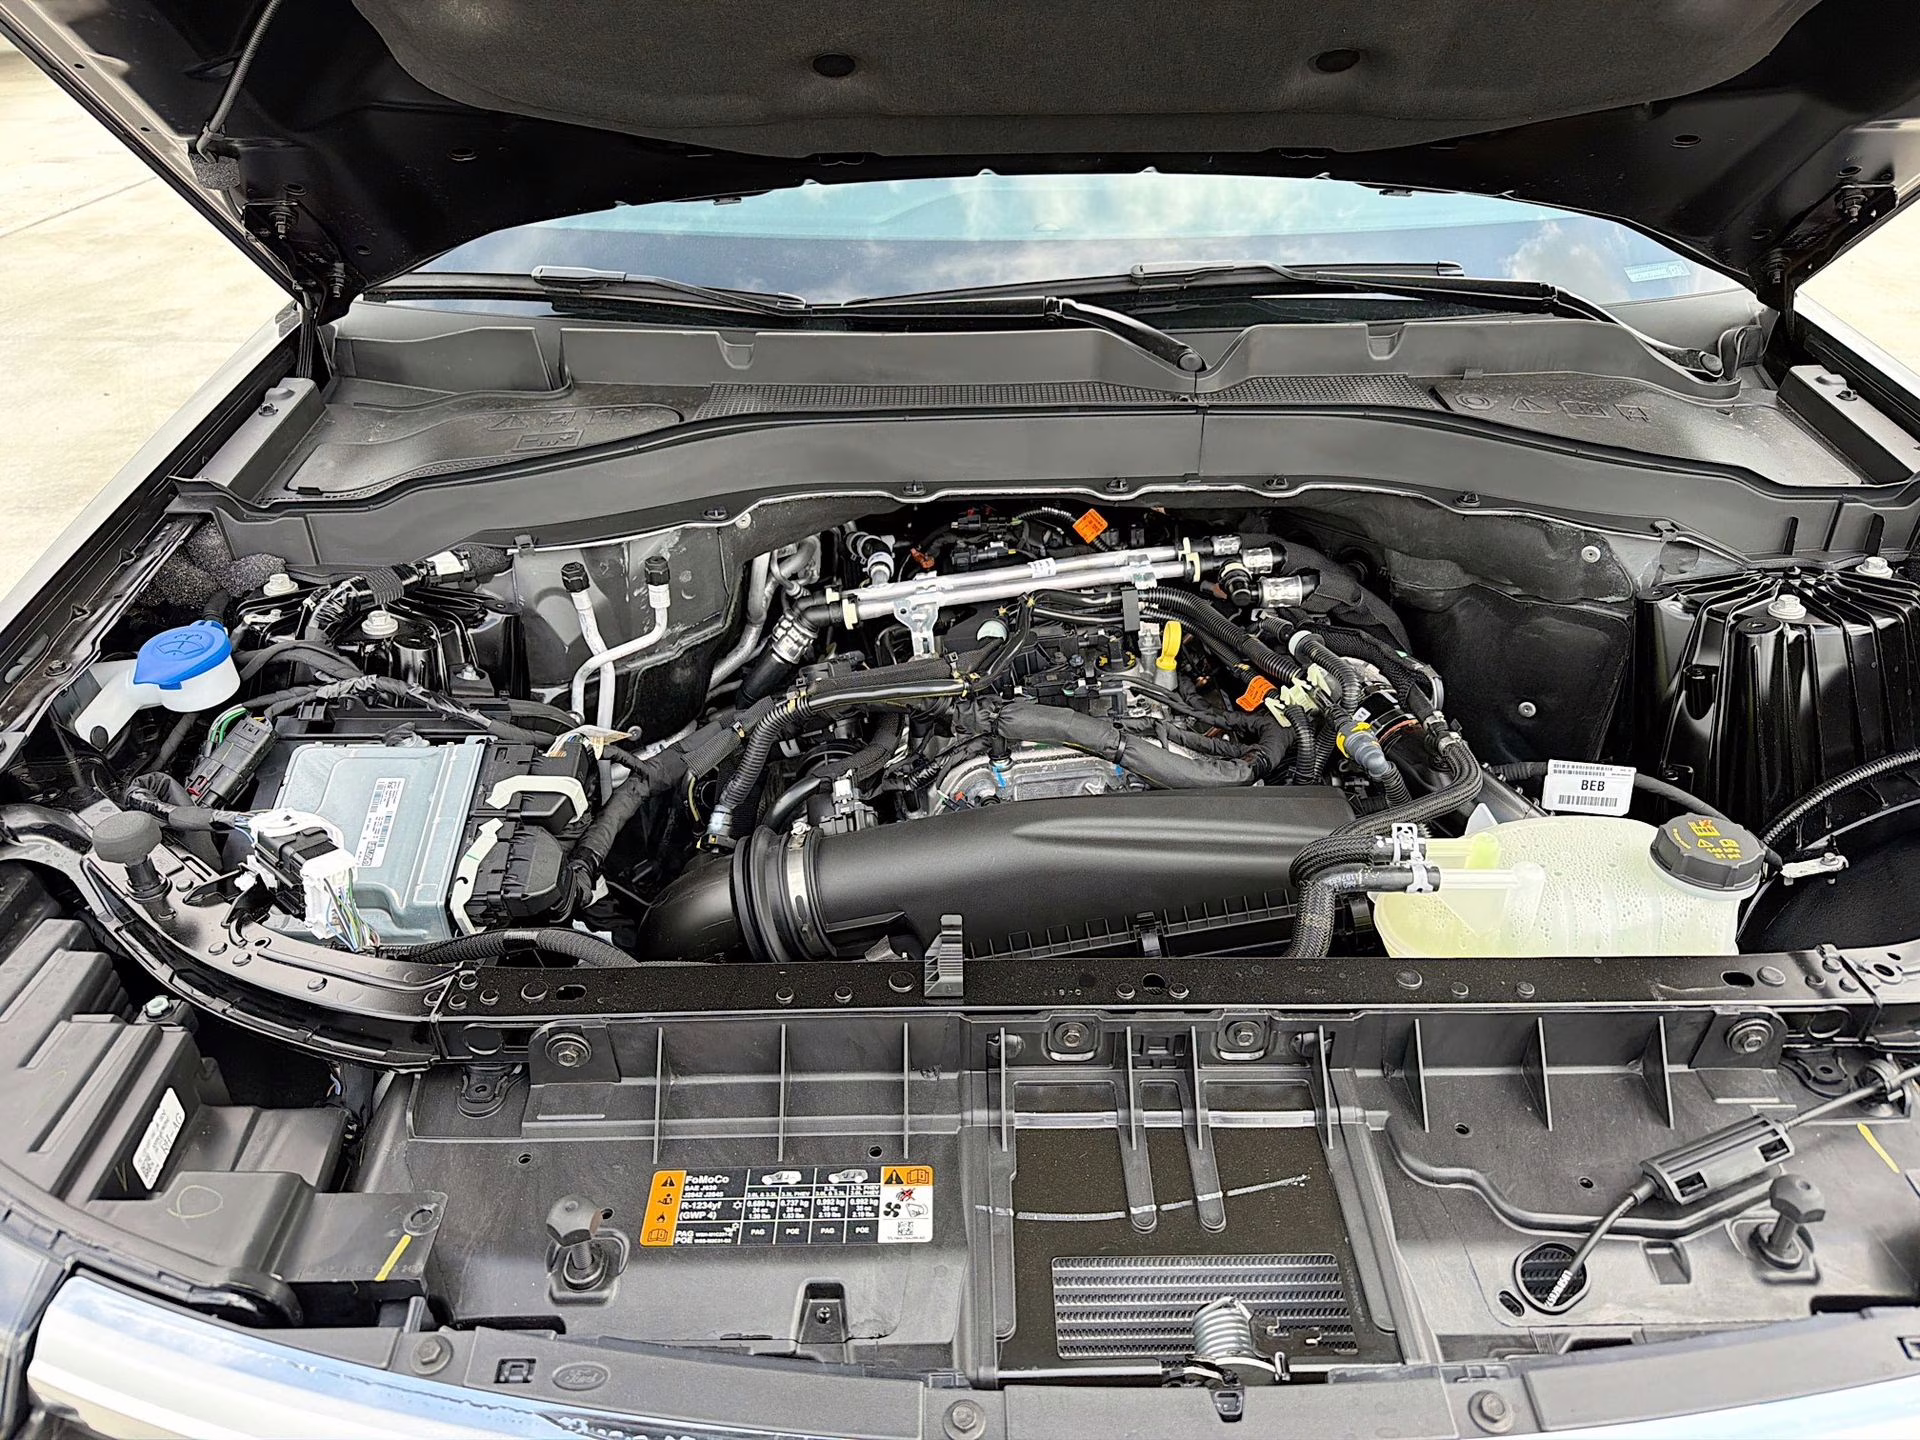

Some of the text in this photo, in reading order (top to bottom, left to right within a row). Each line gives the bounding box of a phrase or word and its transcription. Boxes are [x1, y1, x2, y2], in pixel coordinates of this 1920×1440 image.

[1581, 780, 1605, 792] BEB
[685, 1174, 730, 1184] FoMoCo
[681, 1201, 722, 1210] R-1234yf
[766, 1200, 776, 1208] kg
[800, 1200, 810, 1208] kg
[836, 1198, 845, 1207] kg
[869, 1198, 879, 1206] kg
[679, 1211, 717, 1220] (GWP 4)
